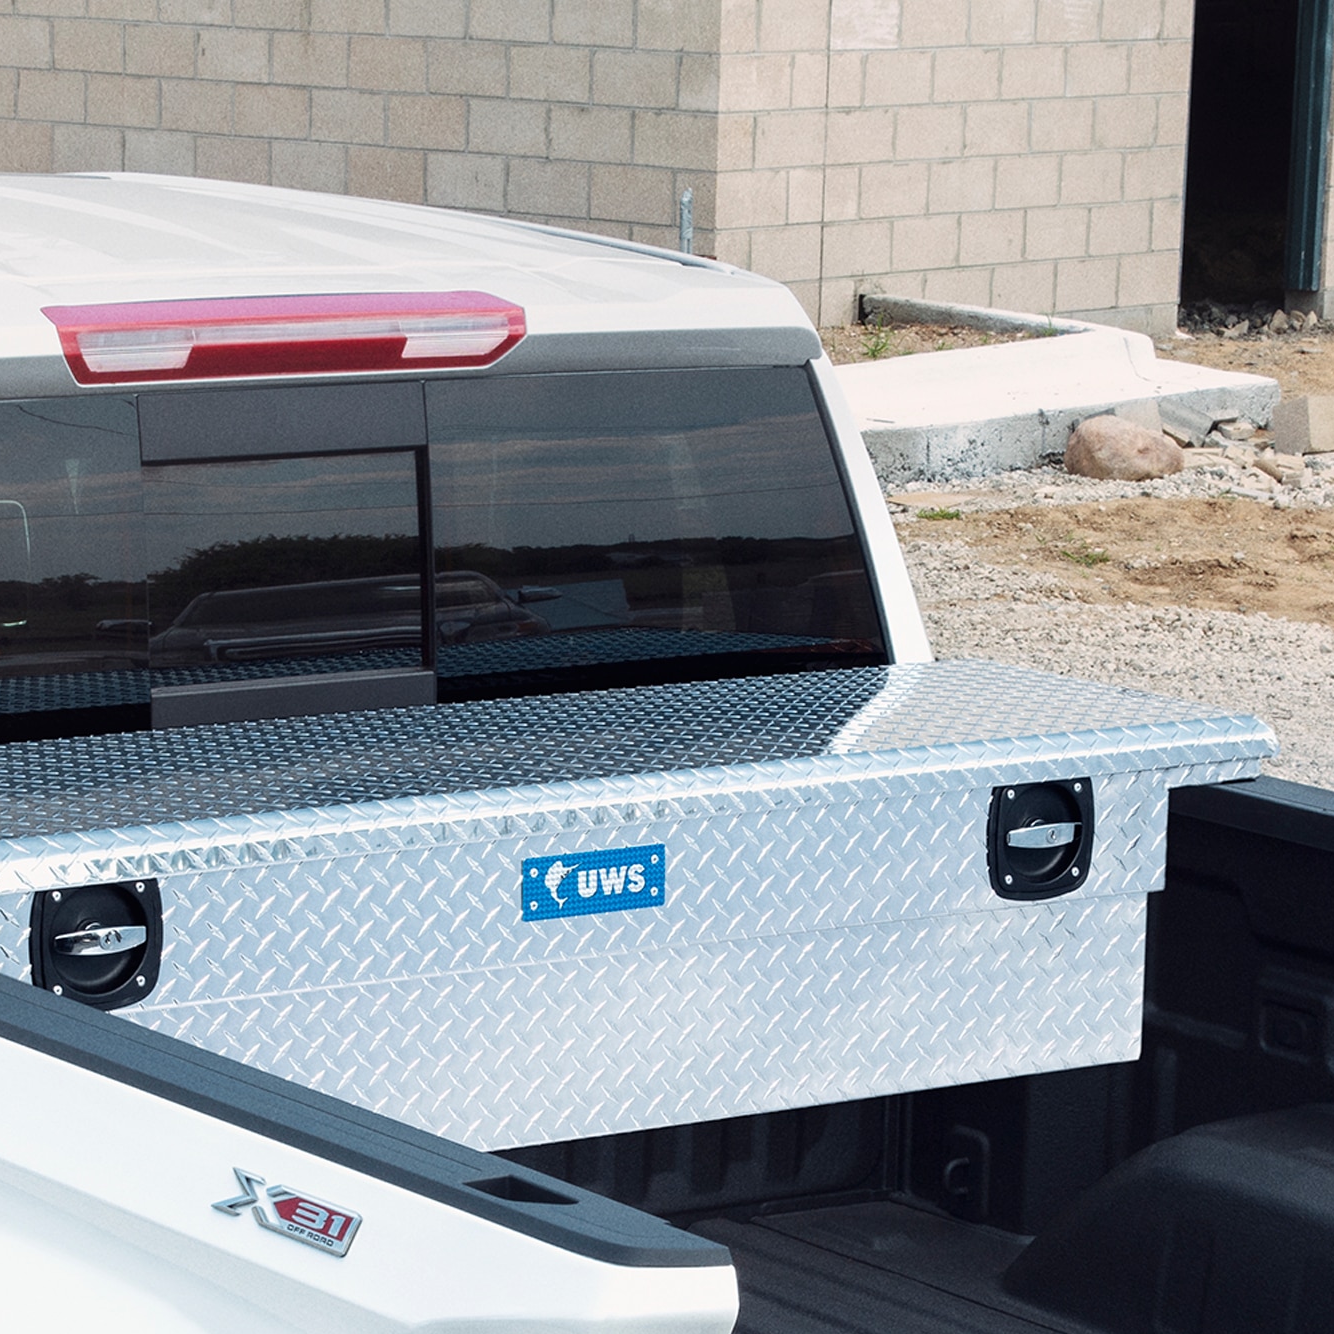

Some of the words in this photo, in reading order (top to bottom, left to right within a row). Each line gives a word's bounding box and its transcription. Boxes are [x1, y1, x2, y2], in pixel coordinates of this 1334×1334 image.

[577, 864, 646, 898] UWS
[286, 1223, 306, 1235] OFF
[306, 1230, 335, 1247] ROAD
